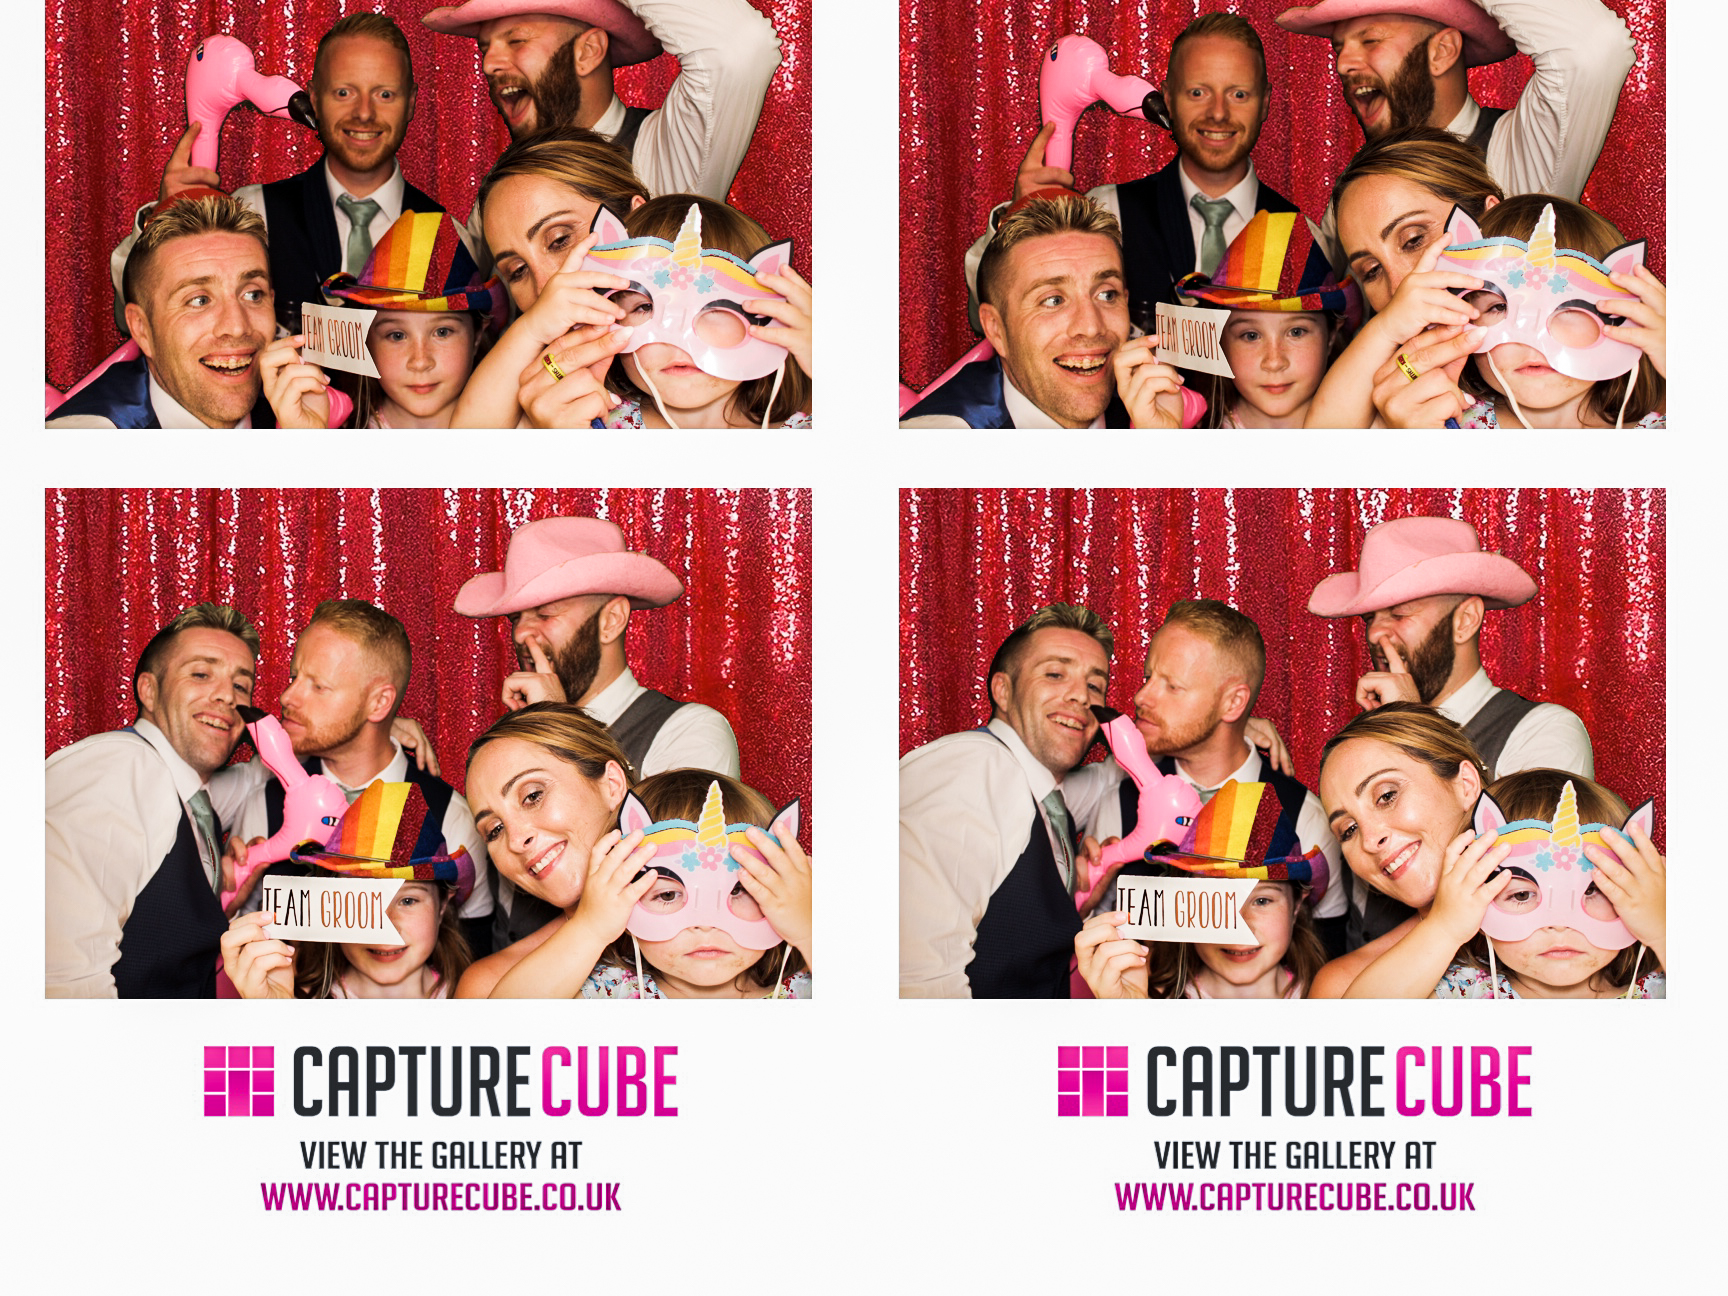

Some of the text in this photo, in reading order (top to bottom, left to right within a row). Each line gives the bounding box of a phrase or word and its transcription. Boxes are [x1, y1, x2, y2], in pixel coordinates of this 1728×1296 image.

[302, 313, 366, 360] TEAM GROOM
[1156, 313, 1220, 360] TEAM GROOM
[263, 887, 383, 929] TEAM GROOM
[1117, 887, 1237, 929] TEAM GROOM
